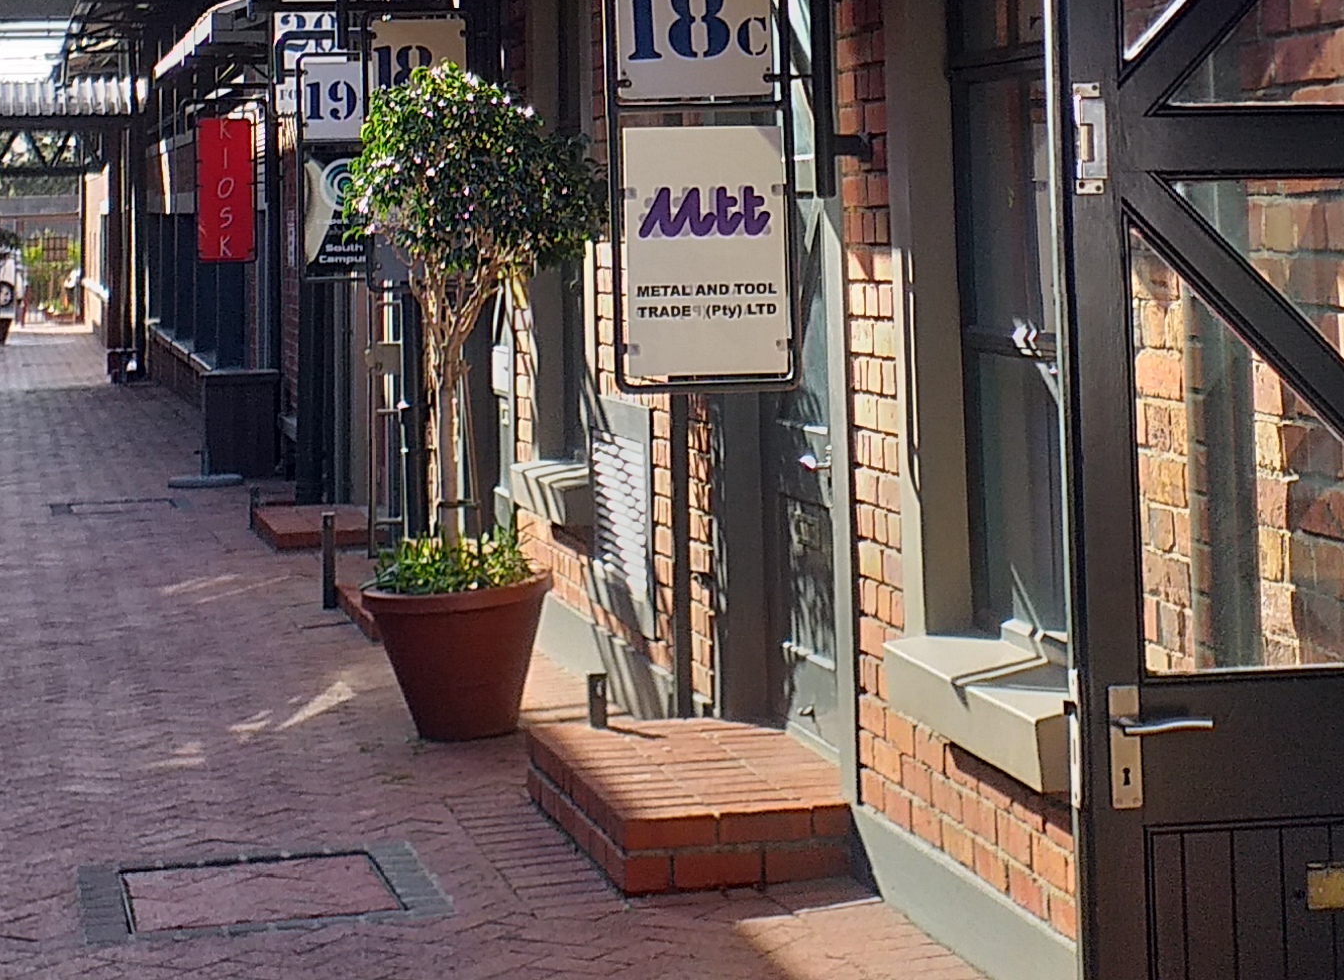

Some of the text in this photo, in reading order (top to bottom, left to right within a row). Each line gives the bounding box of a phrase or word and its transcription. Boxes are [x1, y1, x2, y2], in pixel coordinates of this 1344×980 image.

[307, 81, 357, 120] 19
[217, 120, 235, 257] KIOSK
[325, 243, 363, 252] South
[637, 283, 777, 297] METAL AND TOOL
[638, 304, 777, 319] TRADE (Pty) LTD
